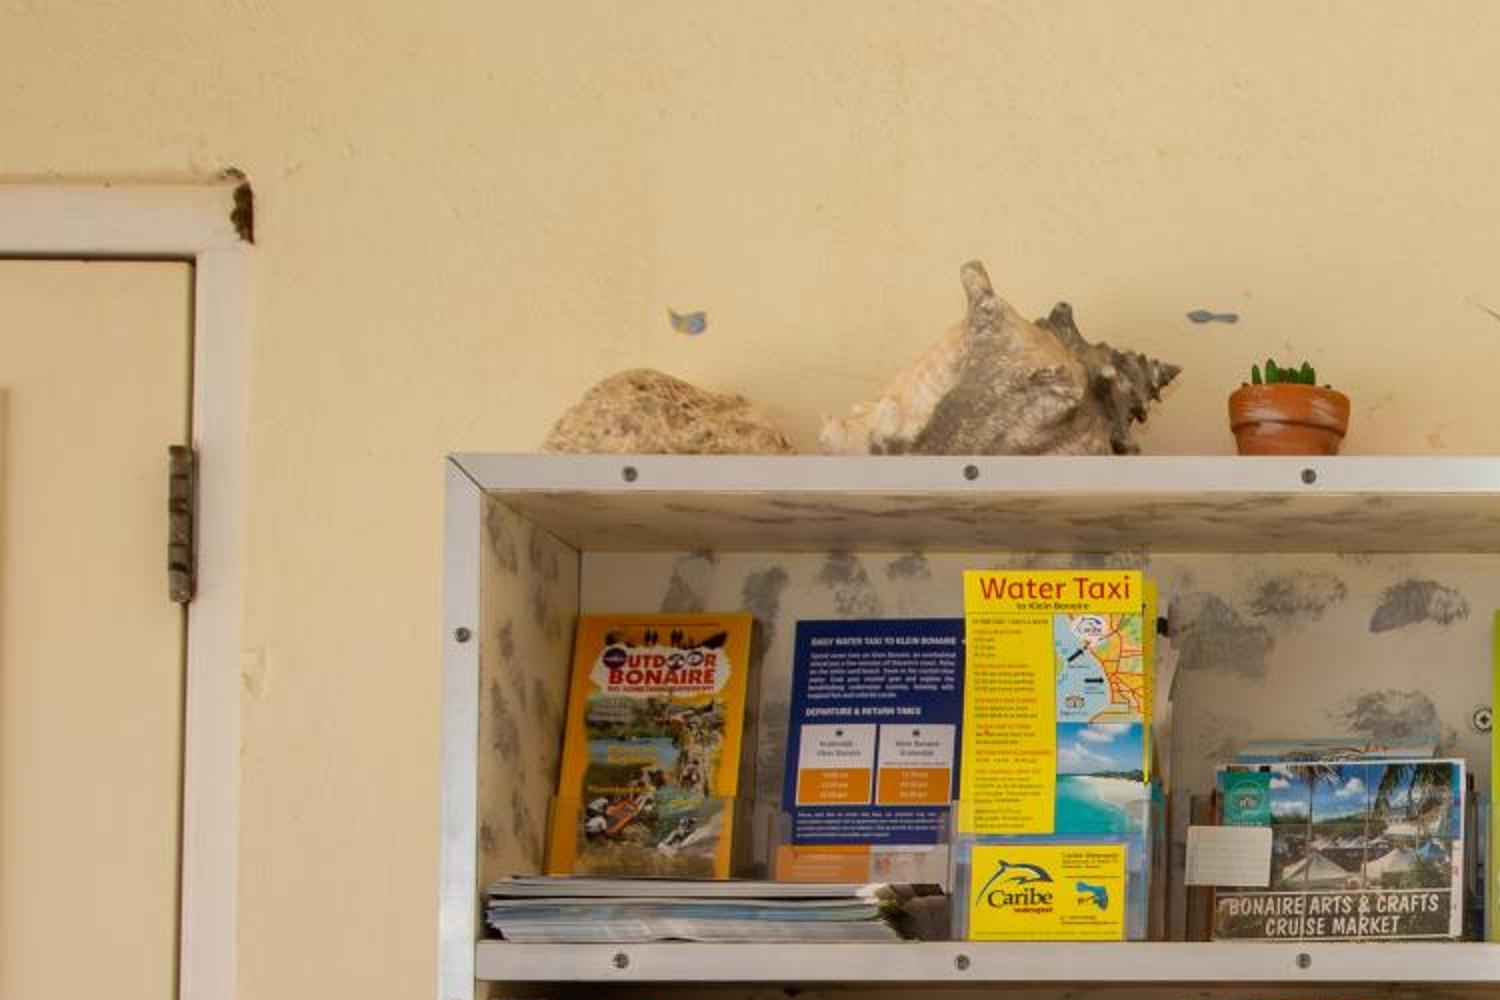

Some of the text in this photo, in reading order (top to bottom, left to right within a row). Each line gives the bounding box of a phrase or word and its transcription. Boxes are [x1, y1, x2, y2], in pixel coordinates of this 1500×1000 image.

[979, 576, 1130, 600] Water Taxi
[608, 669, 715, 685] BONAIRE
[862, 707, 895, 716] RETURN
[988, 886, 1053, 908] Caribe
[1229, 894, 1440, 916] BONAIRE ARTS & CRAFTS
[1265, 916, 1400, 936] CRUISE MARKET
